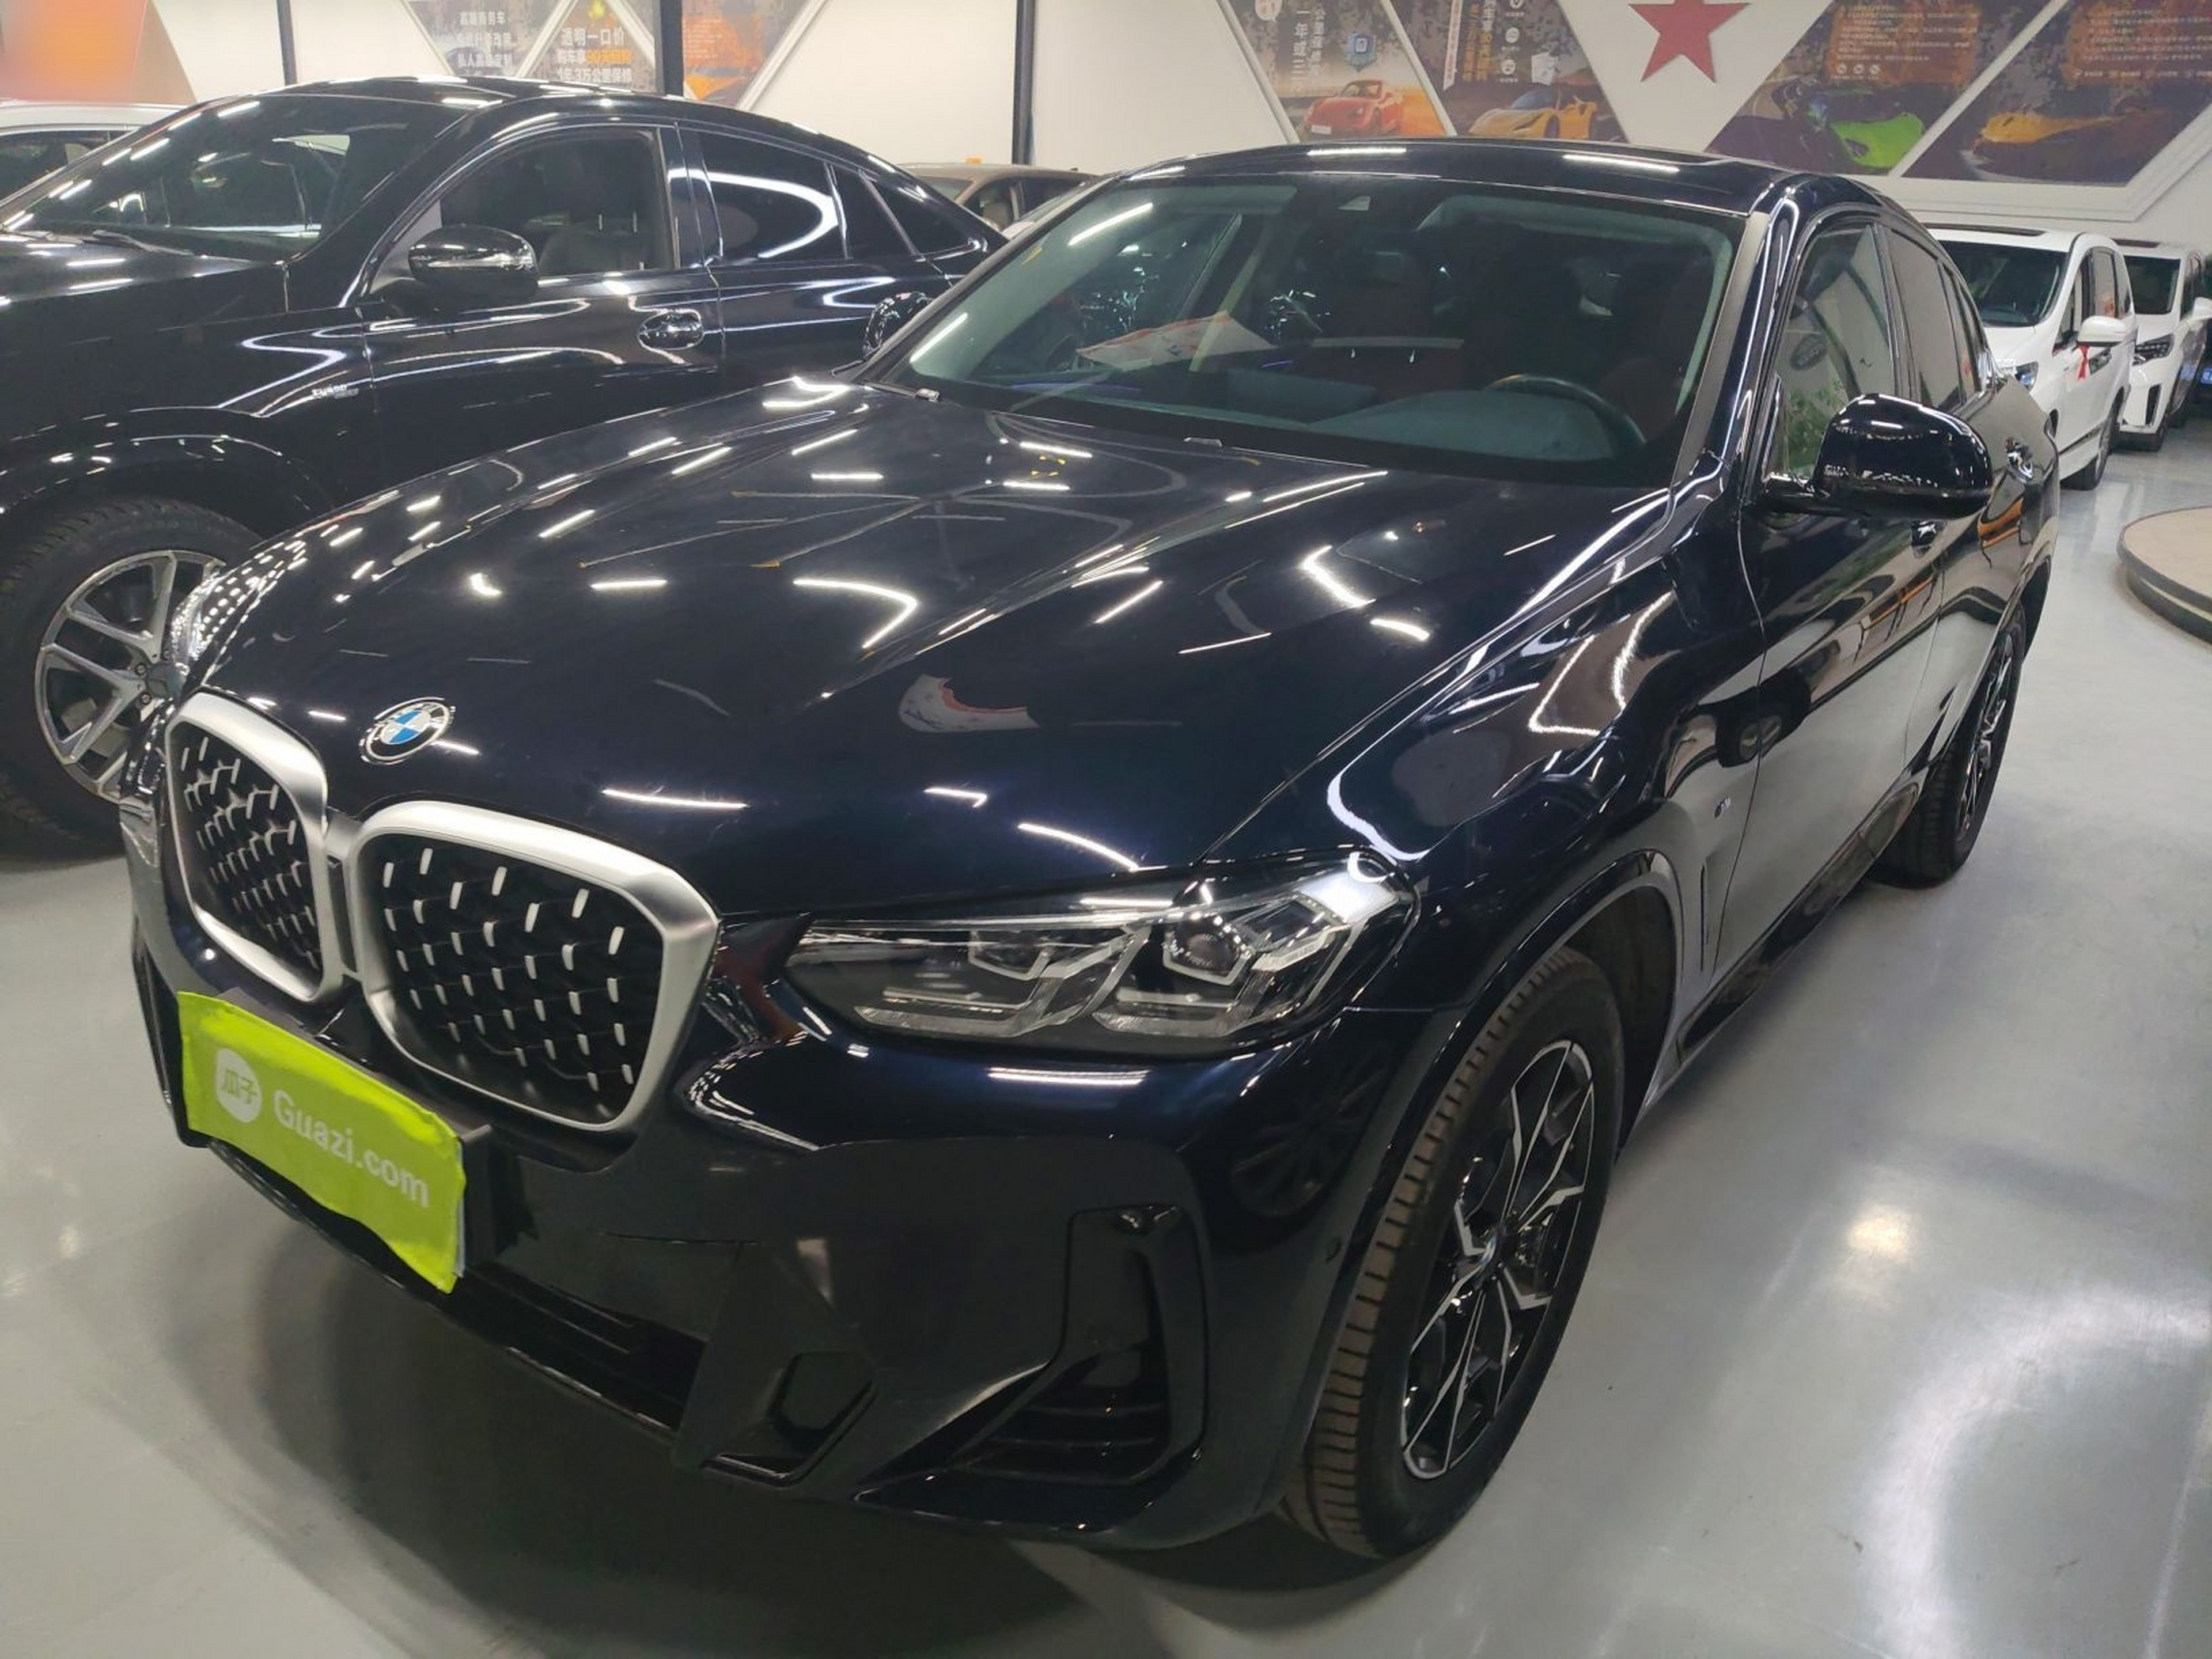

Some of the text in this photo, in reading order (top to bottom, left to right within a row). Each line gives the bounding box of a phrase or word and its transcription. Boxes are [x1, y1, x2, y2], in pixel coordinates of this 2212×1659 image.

[560, 26, 624, 46] 透明一口价
[273, 1089, 430, 1209] Guazi.com
